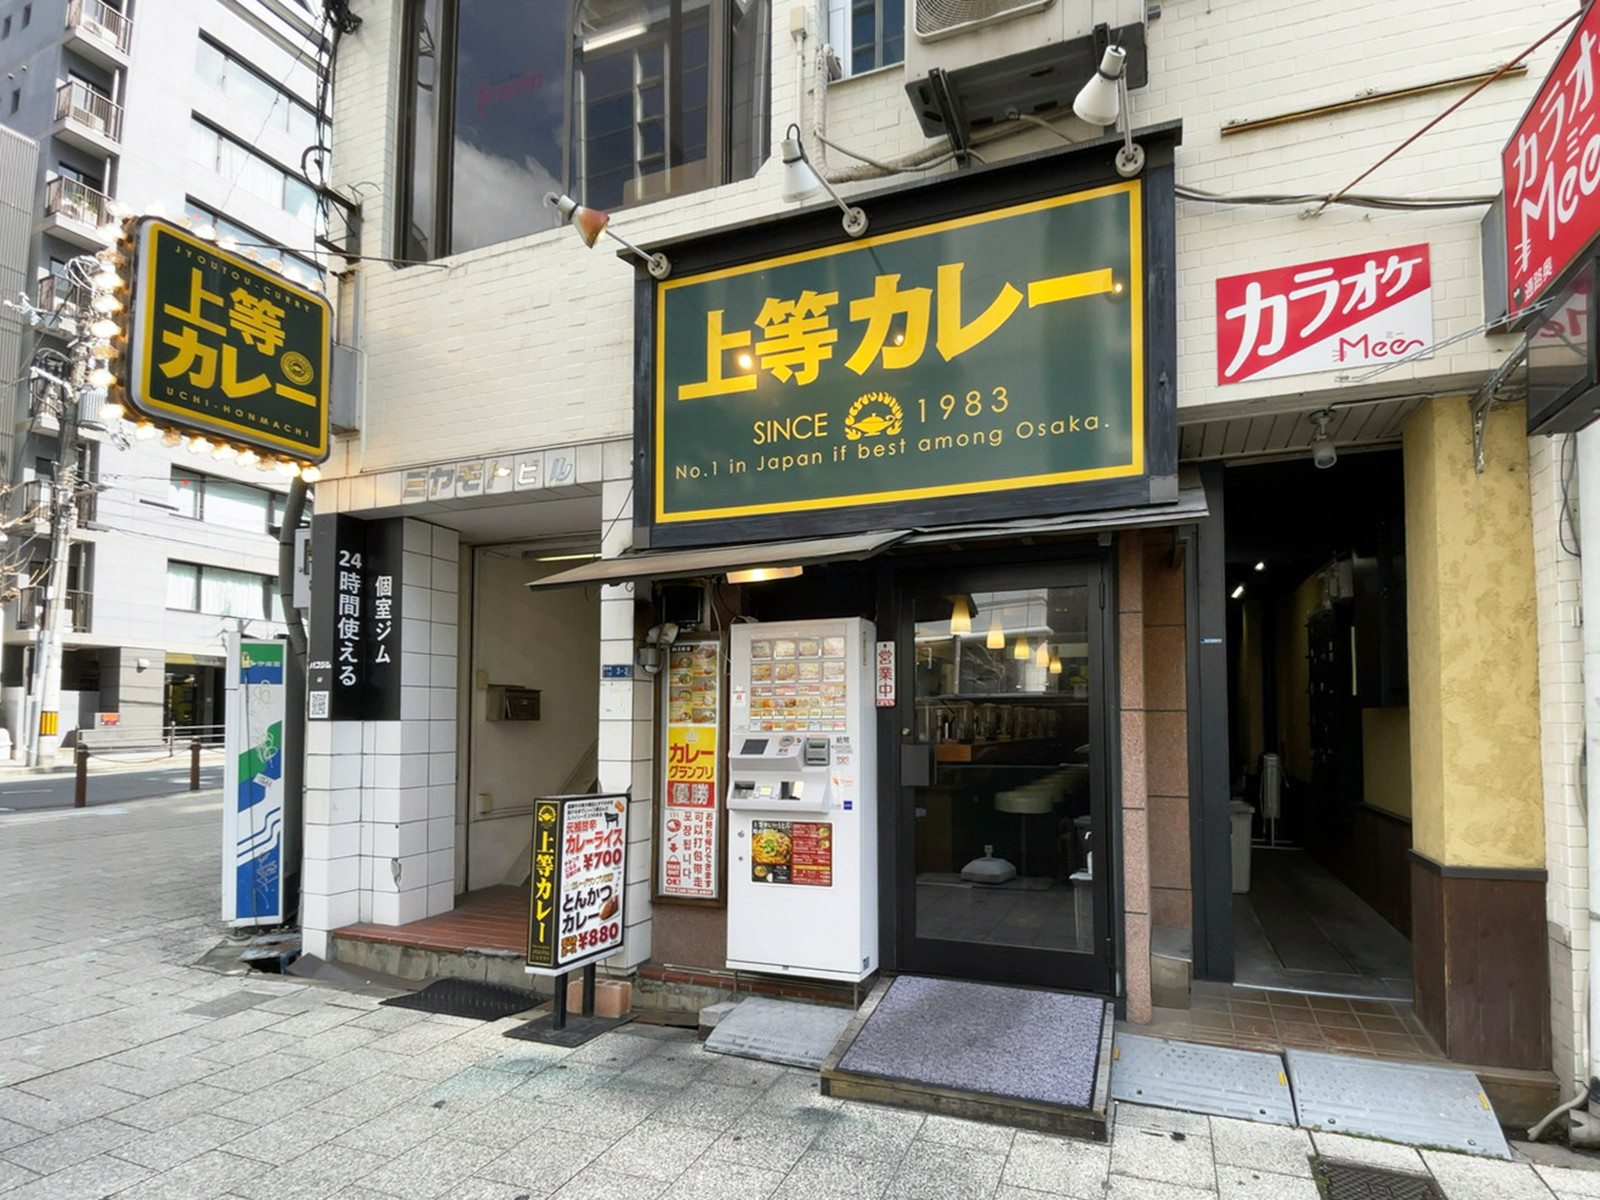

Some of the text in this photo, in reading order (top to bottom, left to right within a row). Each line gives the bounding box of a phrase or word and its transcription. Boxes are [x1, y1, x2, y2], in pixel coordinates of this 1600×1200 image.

[1513, 30, 1600, 208] カラオ
[174, 245, 311, 313] JYOUTOU-CURRY
[164, 267, 286, 357] 上等
[677, 262, 1113, 402] 上等カレー
[1223, 255, 1423, 378] カラオケ
[158, 325, 317, 408] カレー
[166, 386, 311, 439] UCHI-HONMACHI
[752, 386, 1011, 446] SINCE 1983
[675, 413, 1111, 480] No.1 in Japan if best among Osaka.
[403, 457, 573, 498] ミヤモトビル
[338, 549, 363, 687] 24時間使える
[374, 575, 393, 664] 個室ジム
[878, 649, 893, 698] 営業中
[669, 743, 714, 763] カレー
[669, 765, 714, 780] グランプリ
[565, 828, 623, 855] カレーライス
[583, 848, 623, 872] ¥700
[535, 831, 555, 943] 上等カレー
[562, 884, 613, 913] とんかつ
[562, 912, 600, 935] カレー
[578, 921, 620, 951] ¥880
